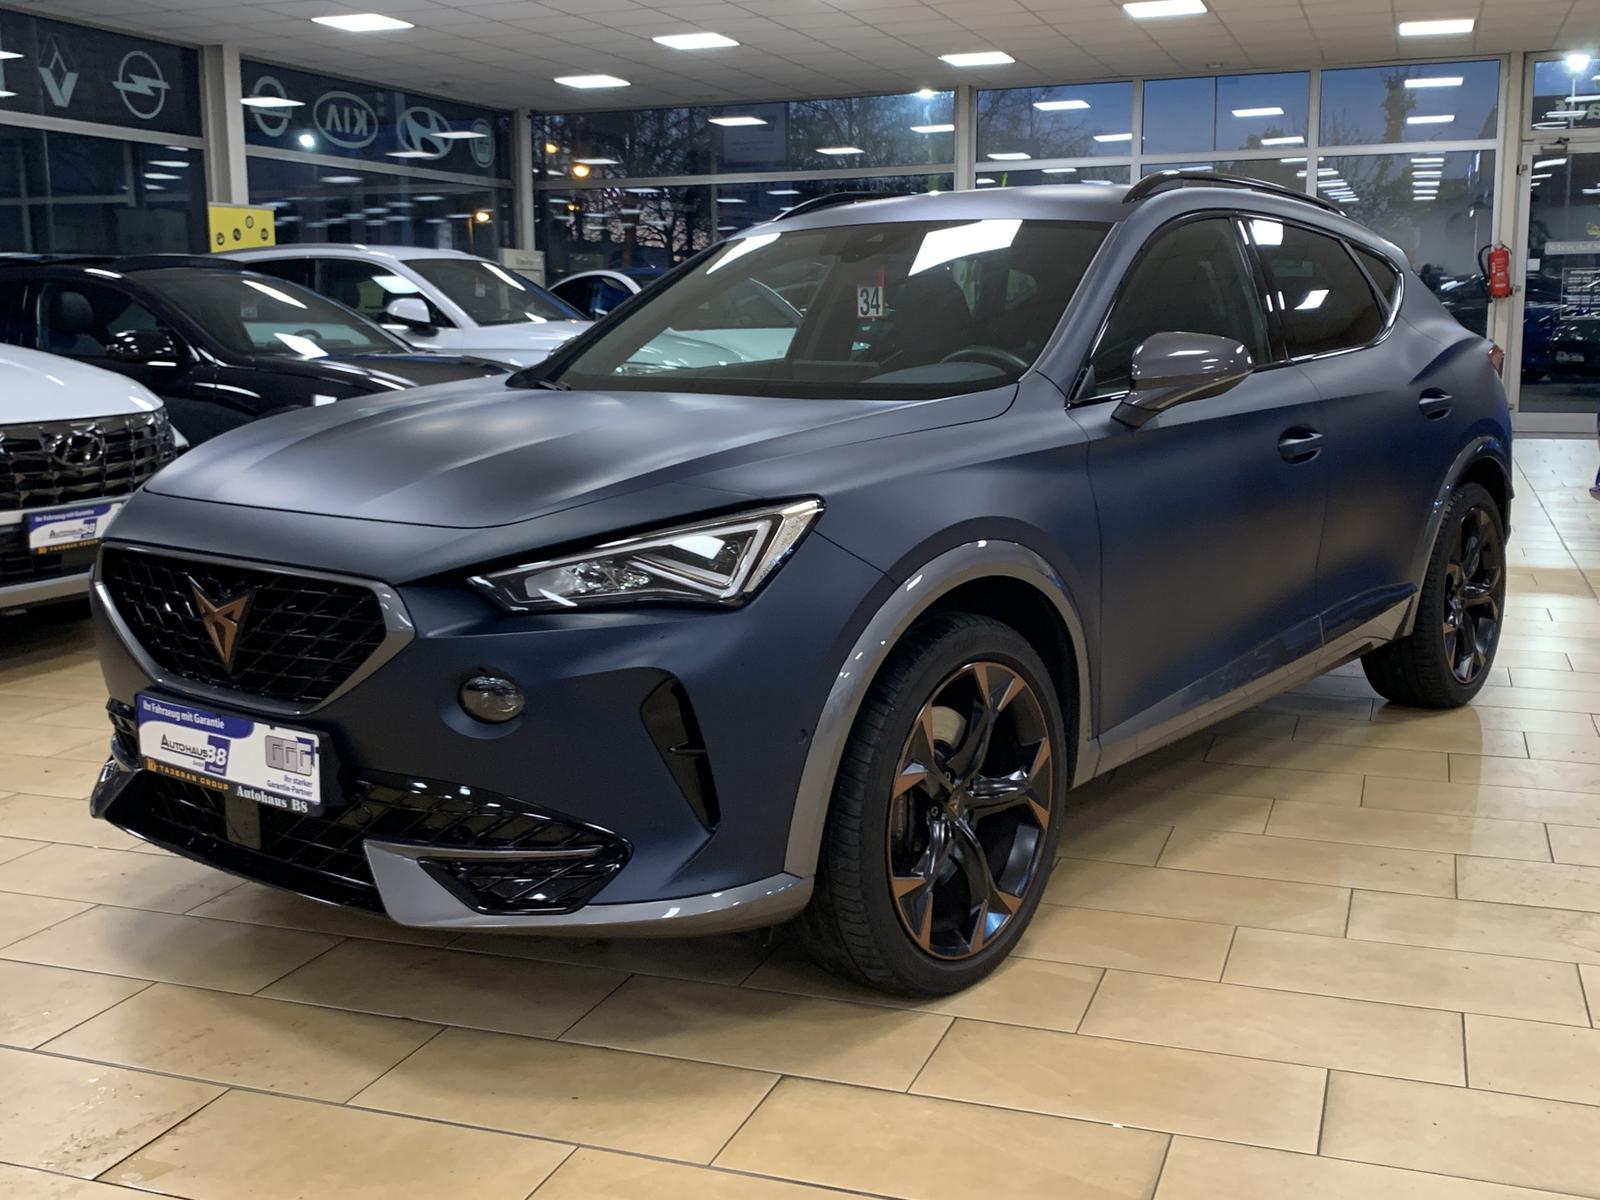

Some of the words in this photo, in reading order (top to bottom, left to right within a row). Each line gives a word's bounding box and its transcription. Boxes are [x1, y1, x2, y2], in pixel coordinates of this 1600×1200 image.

[860, 288, 881, 315] 34
[143, 700, 152, 711] Ihr
[152, 703, 180, 721] Fahrzeug
[181, 711, 194, 723] mit
[193, 713, 225, 729] Garantie
[237, 785, 288, 808] Autohaus
[291, 798, 308, 813] B8
